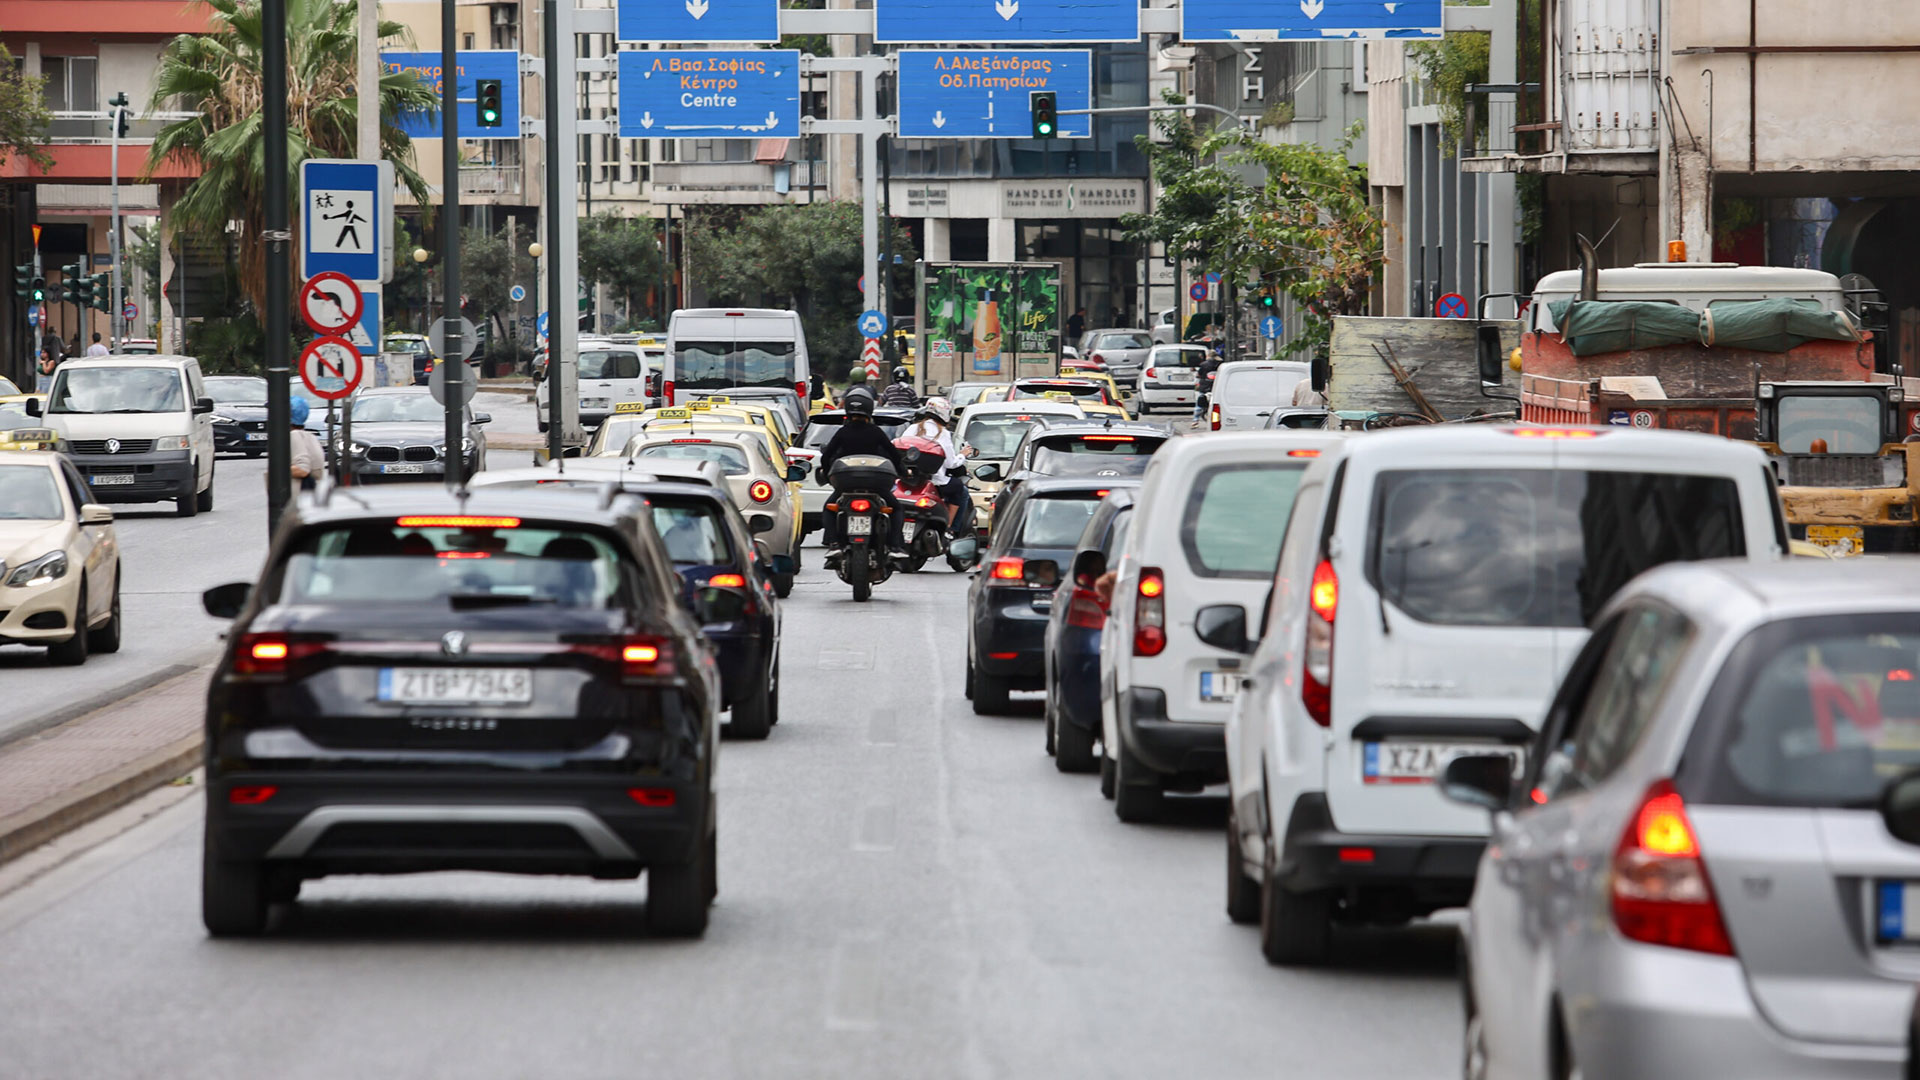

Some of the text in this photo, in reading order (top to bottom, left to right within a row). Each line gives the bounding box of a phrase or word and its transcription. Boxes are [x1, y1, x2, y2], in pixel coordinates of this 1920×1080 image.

[652, 58, 766, 75] Λ.Βασ.Σοφίας
[934, 56, 1052, 73] Λ.Αλεξάνδρας
[680, 75, 738, 92] Κέντρο
[939, 73, 1048, 91] Οδ.Πατησίων
[680, 92, 737, 108] Centre
[1006, 189, 1137, 199] HANDLES HANDLES
[1023, 310, 1048, 329] Life
[617, 403, 641, 411] TAXI
[1636, 415, 1650, 426] 80
